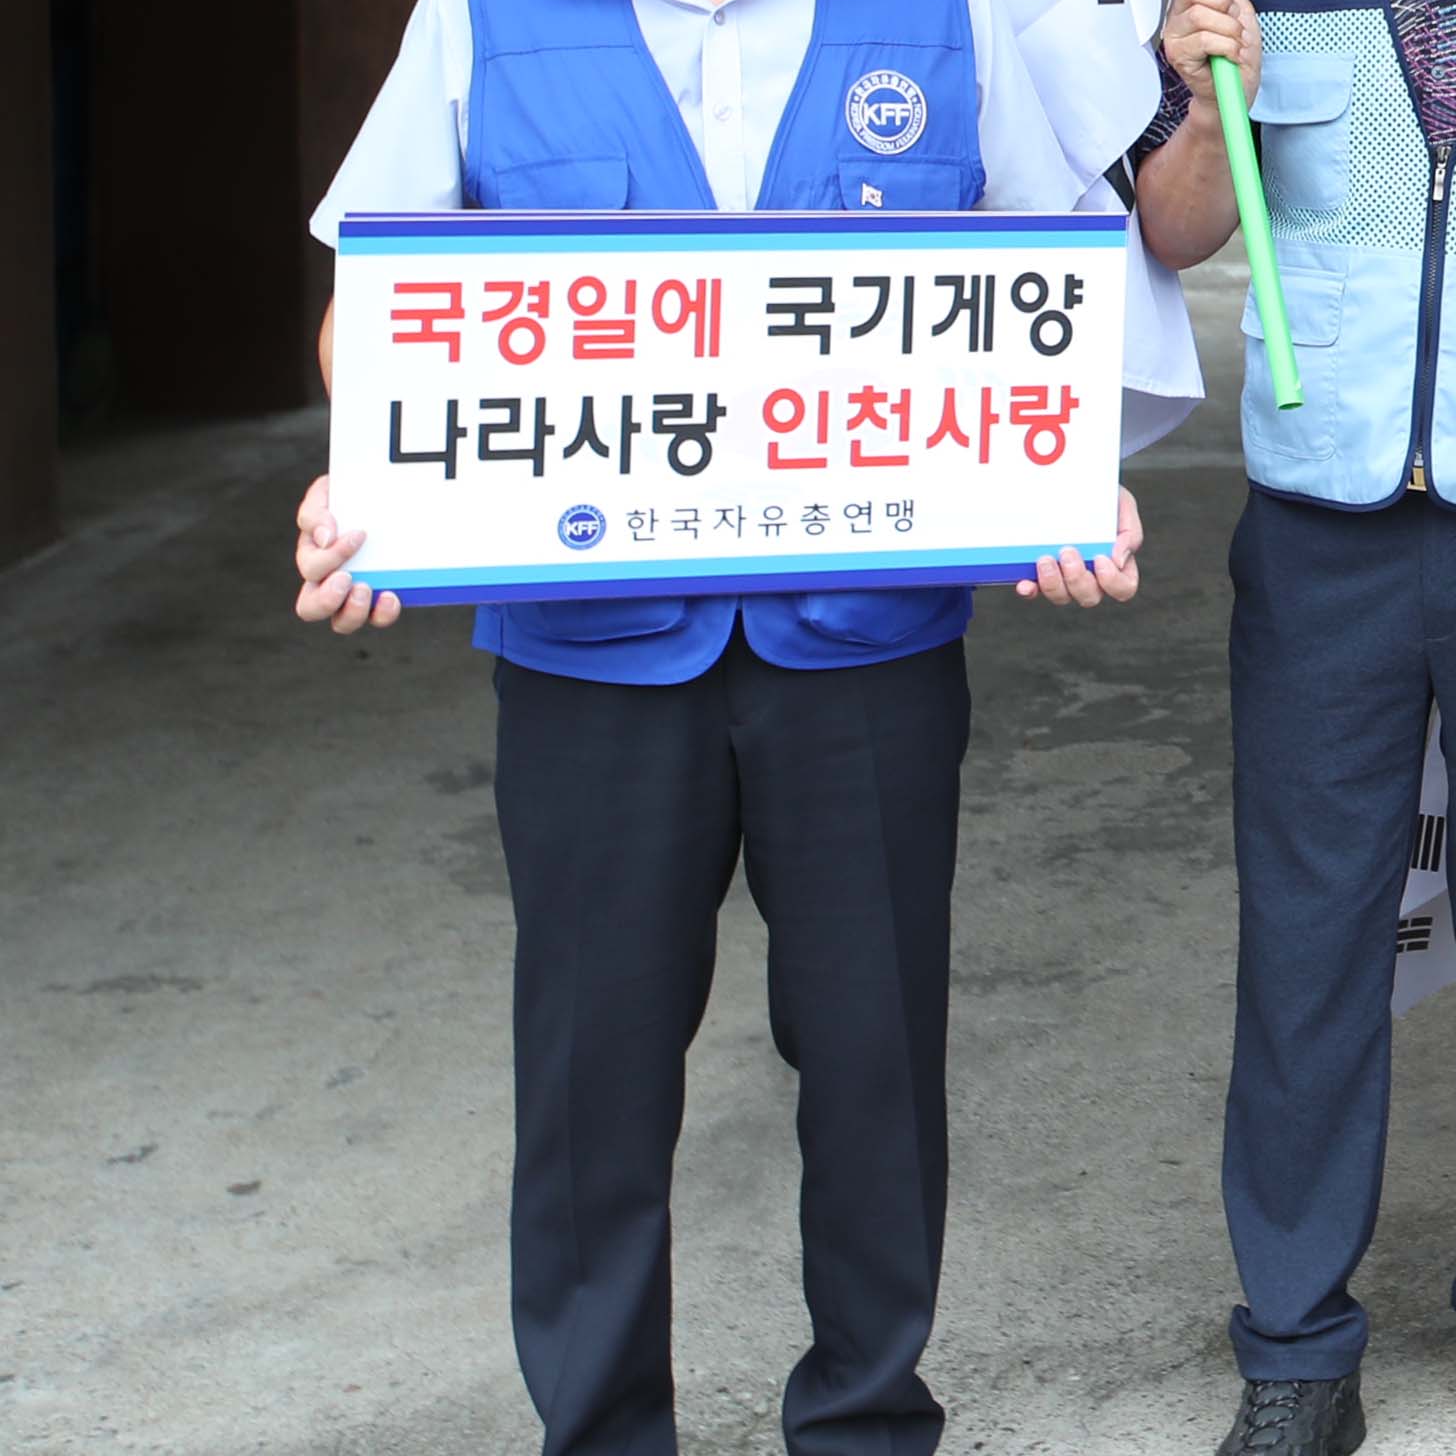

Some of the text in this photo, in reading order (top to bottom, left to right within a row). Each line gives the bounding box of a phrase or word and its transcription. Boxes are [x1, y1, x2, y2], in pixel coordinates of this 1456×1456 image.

[863, 103, 911, 126] KFF
[391, 272, 1084, 366] 국경일에 국기게양
[389, 384, 1080, 480] 나라사랑 인천사랑
[565, 520, 599, 537] KFF
[625, 499, 916, 542] 한국자유총연맹
